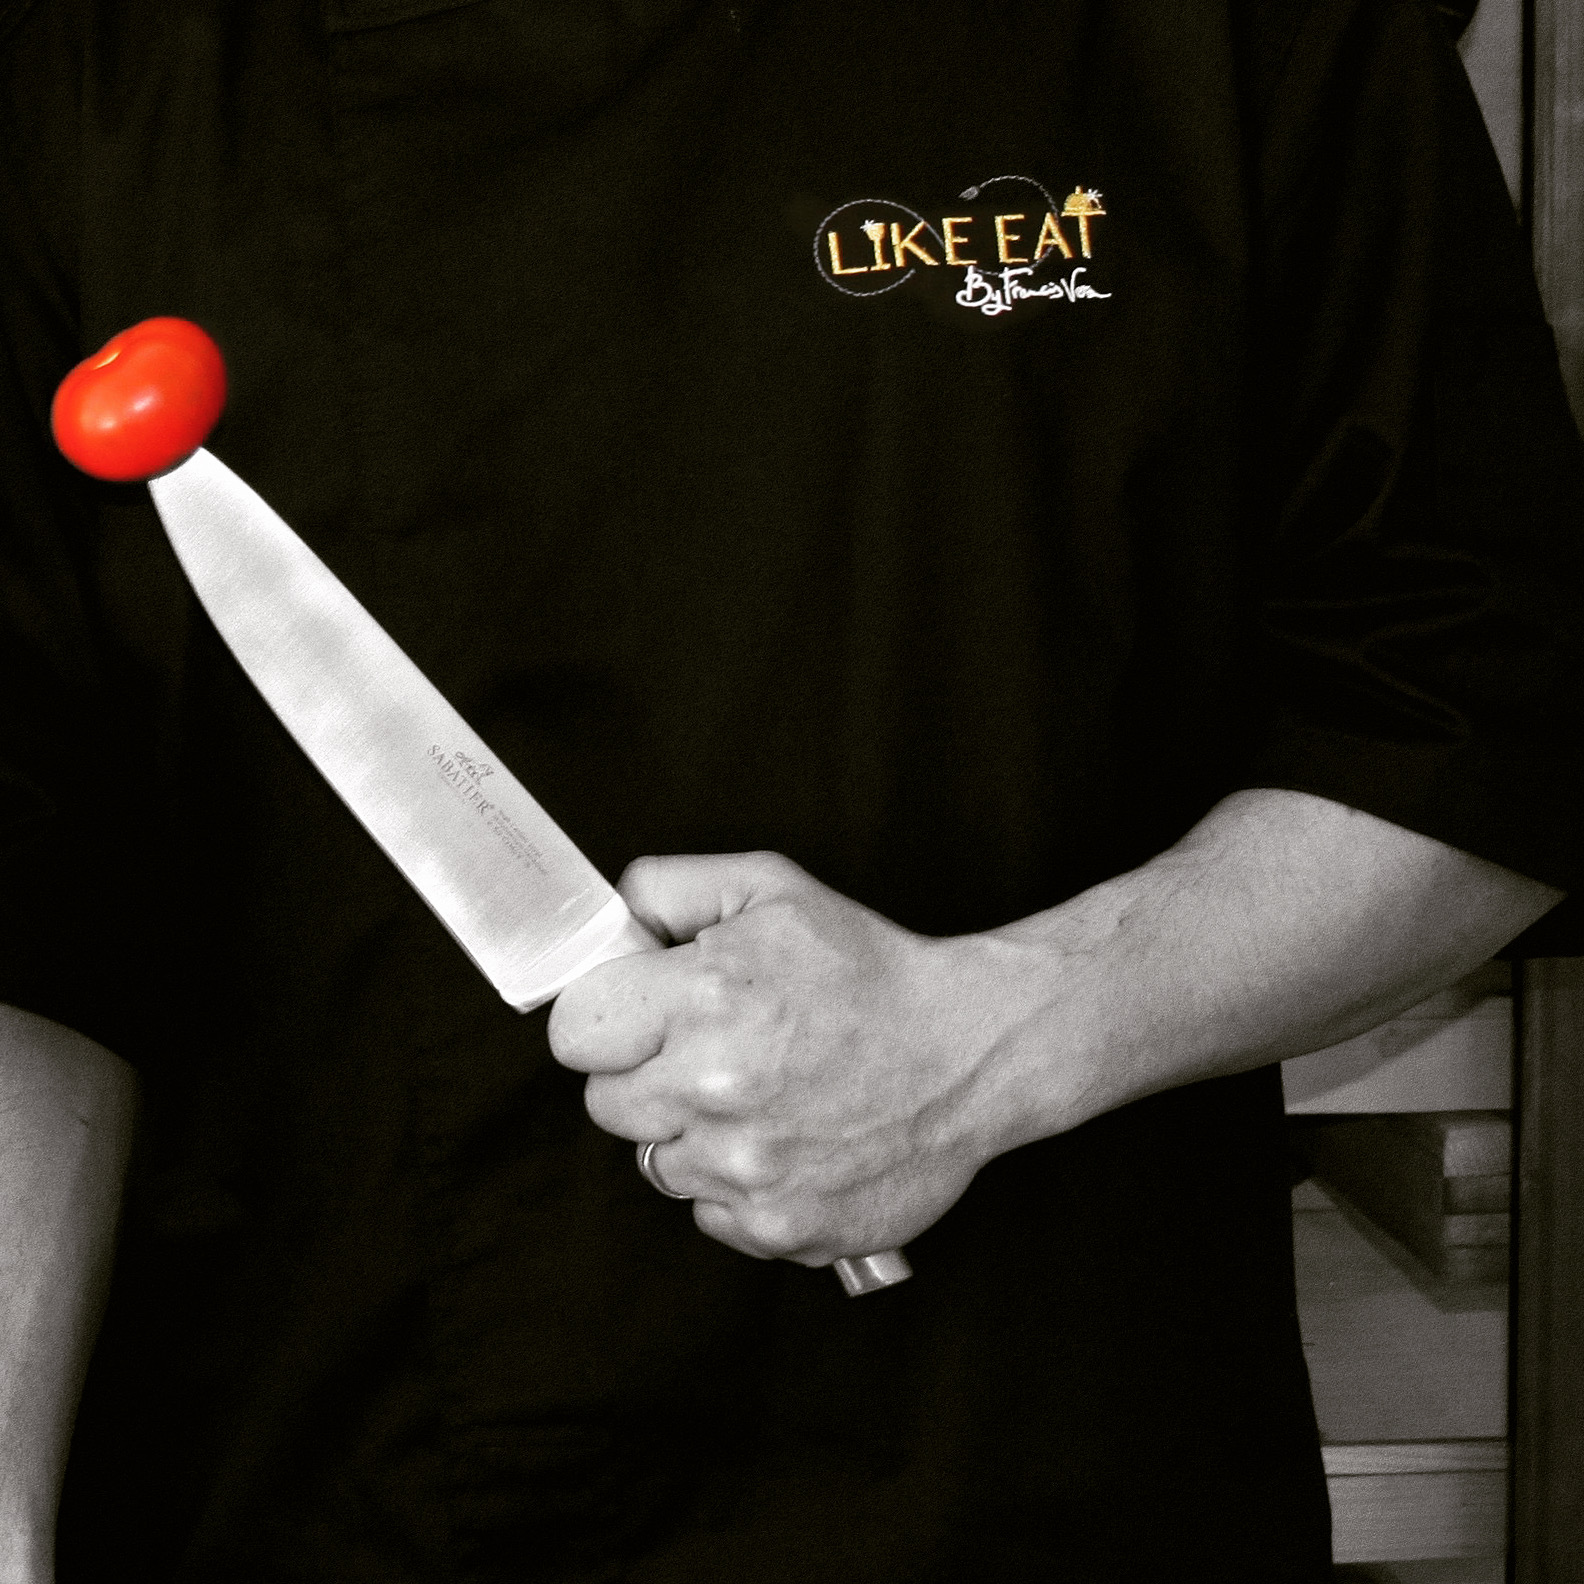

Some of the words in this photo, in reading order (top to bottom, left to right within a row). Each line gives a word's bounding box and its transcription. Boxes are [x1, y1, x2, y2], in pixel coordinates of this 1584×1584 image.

[827, 216, 978, 275] LIKE
[994, 208, 1107, 264] EAT
[427, 744, 490, 816] SABATIER
